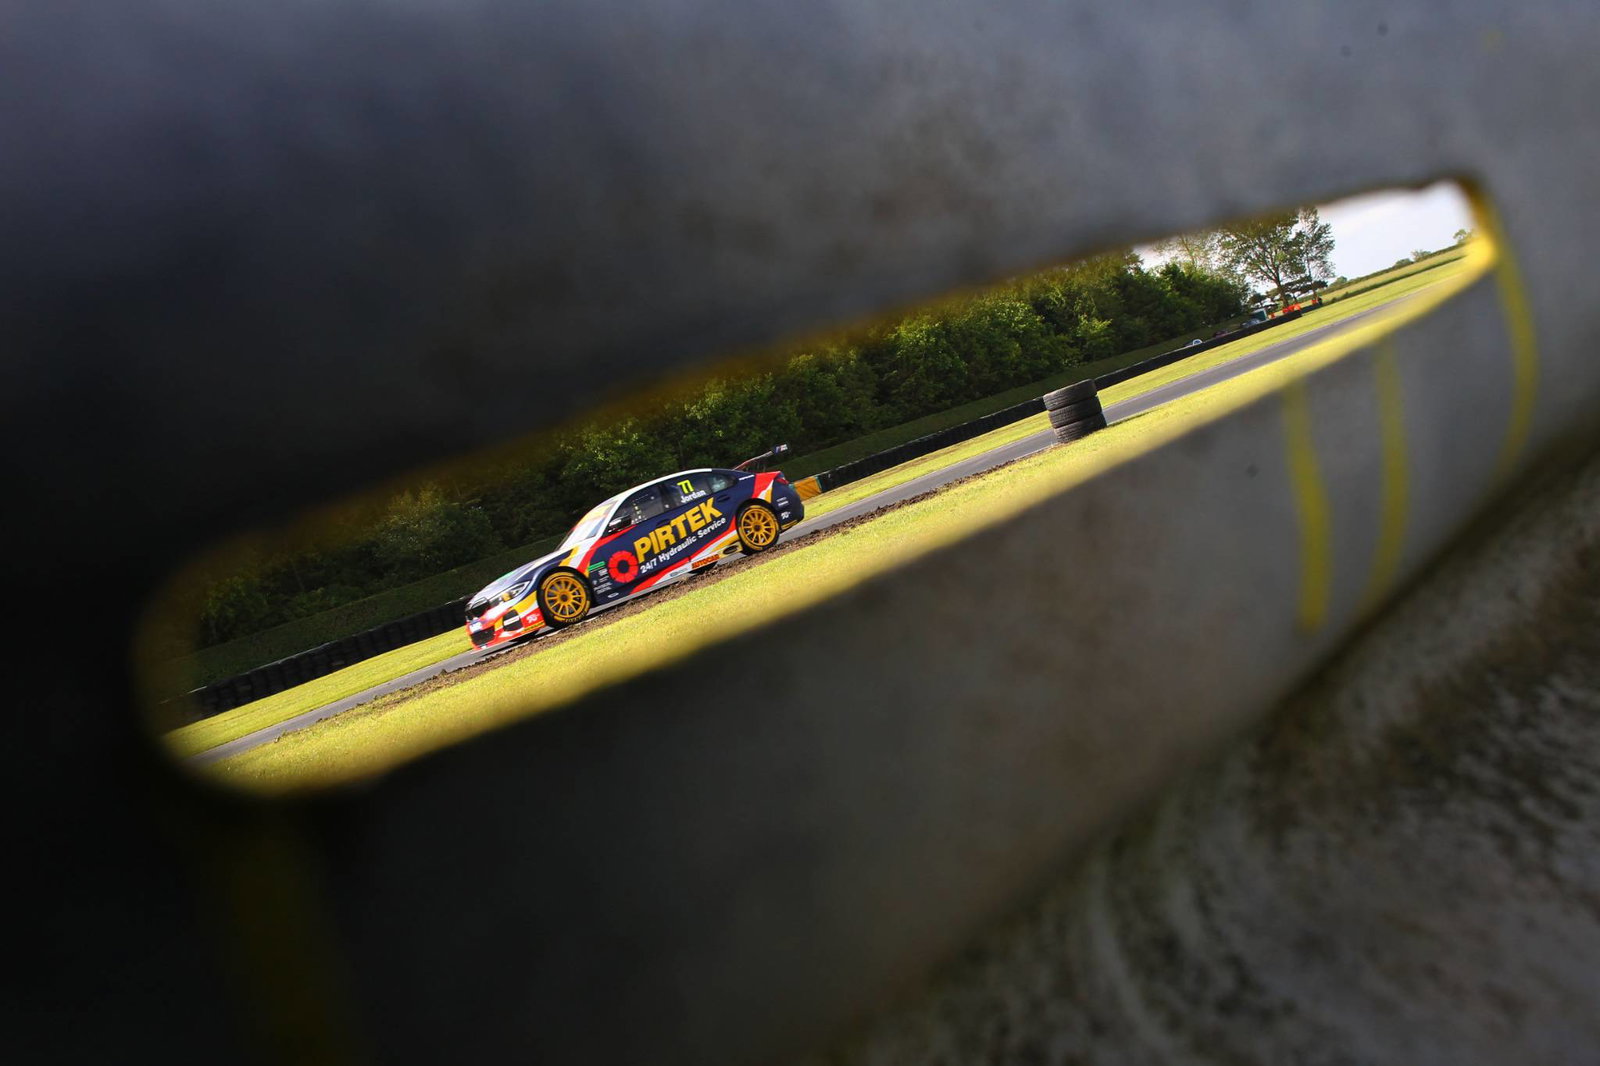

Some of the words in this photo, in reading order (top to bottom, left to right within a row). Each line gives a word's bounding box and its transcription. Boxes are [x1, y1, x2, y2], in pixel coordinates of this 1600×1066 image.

[677, 480, 694, 494] 77
[680, 490, 706, 503] Jordan
[633, 497, 722, 564] PIRTEK
[640, 557, 657, 573] 24/7
[659, 536, 697, 562] Hydraulic
[697, 517, 726, 538] Service
